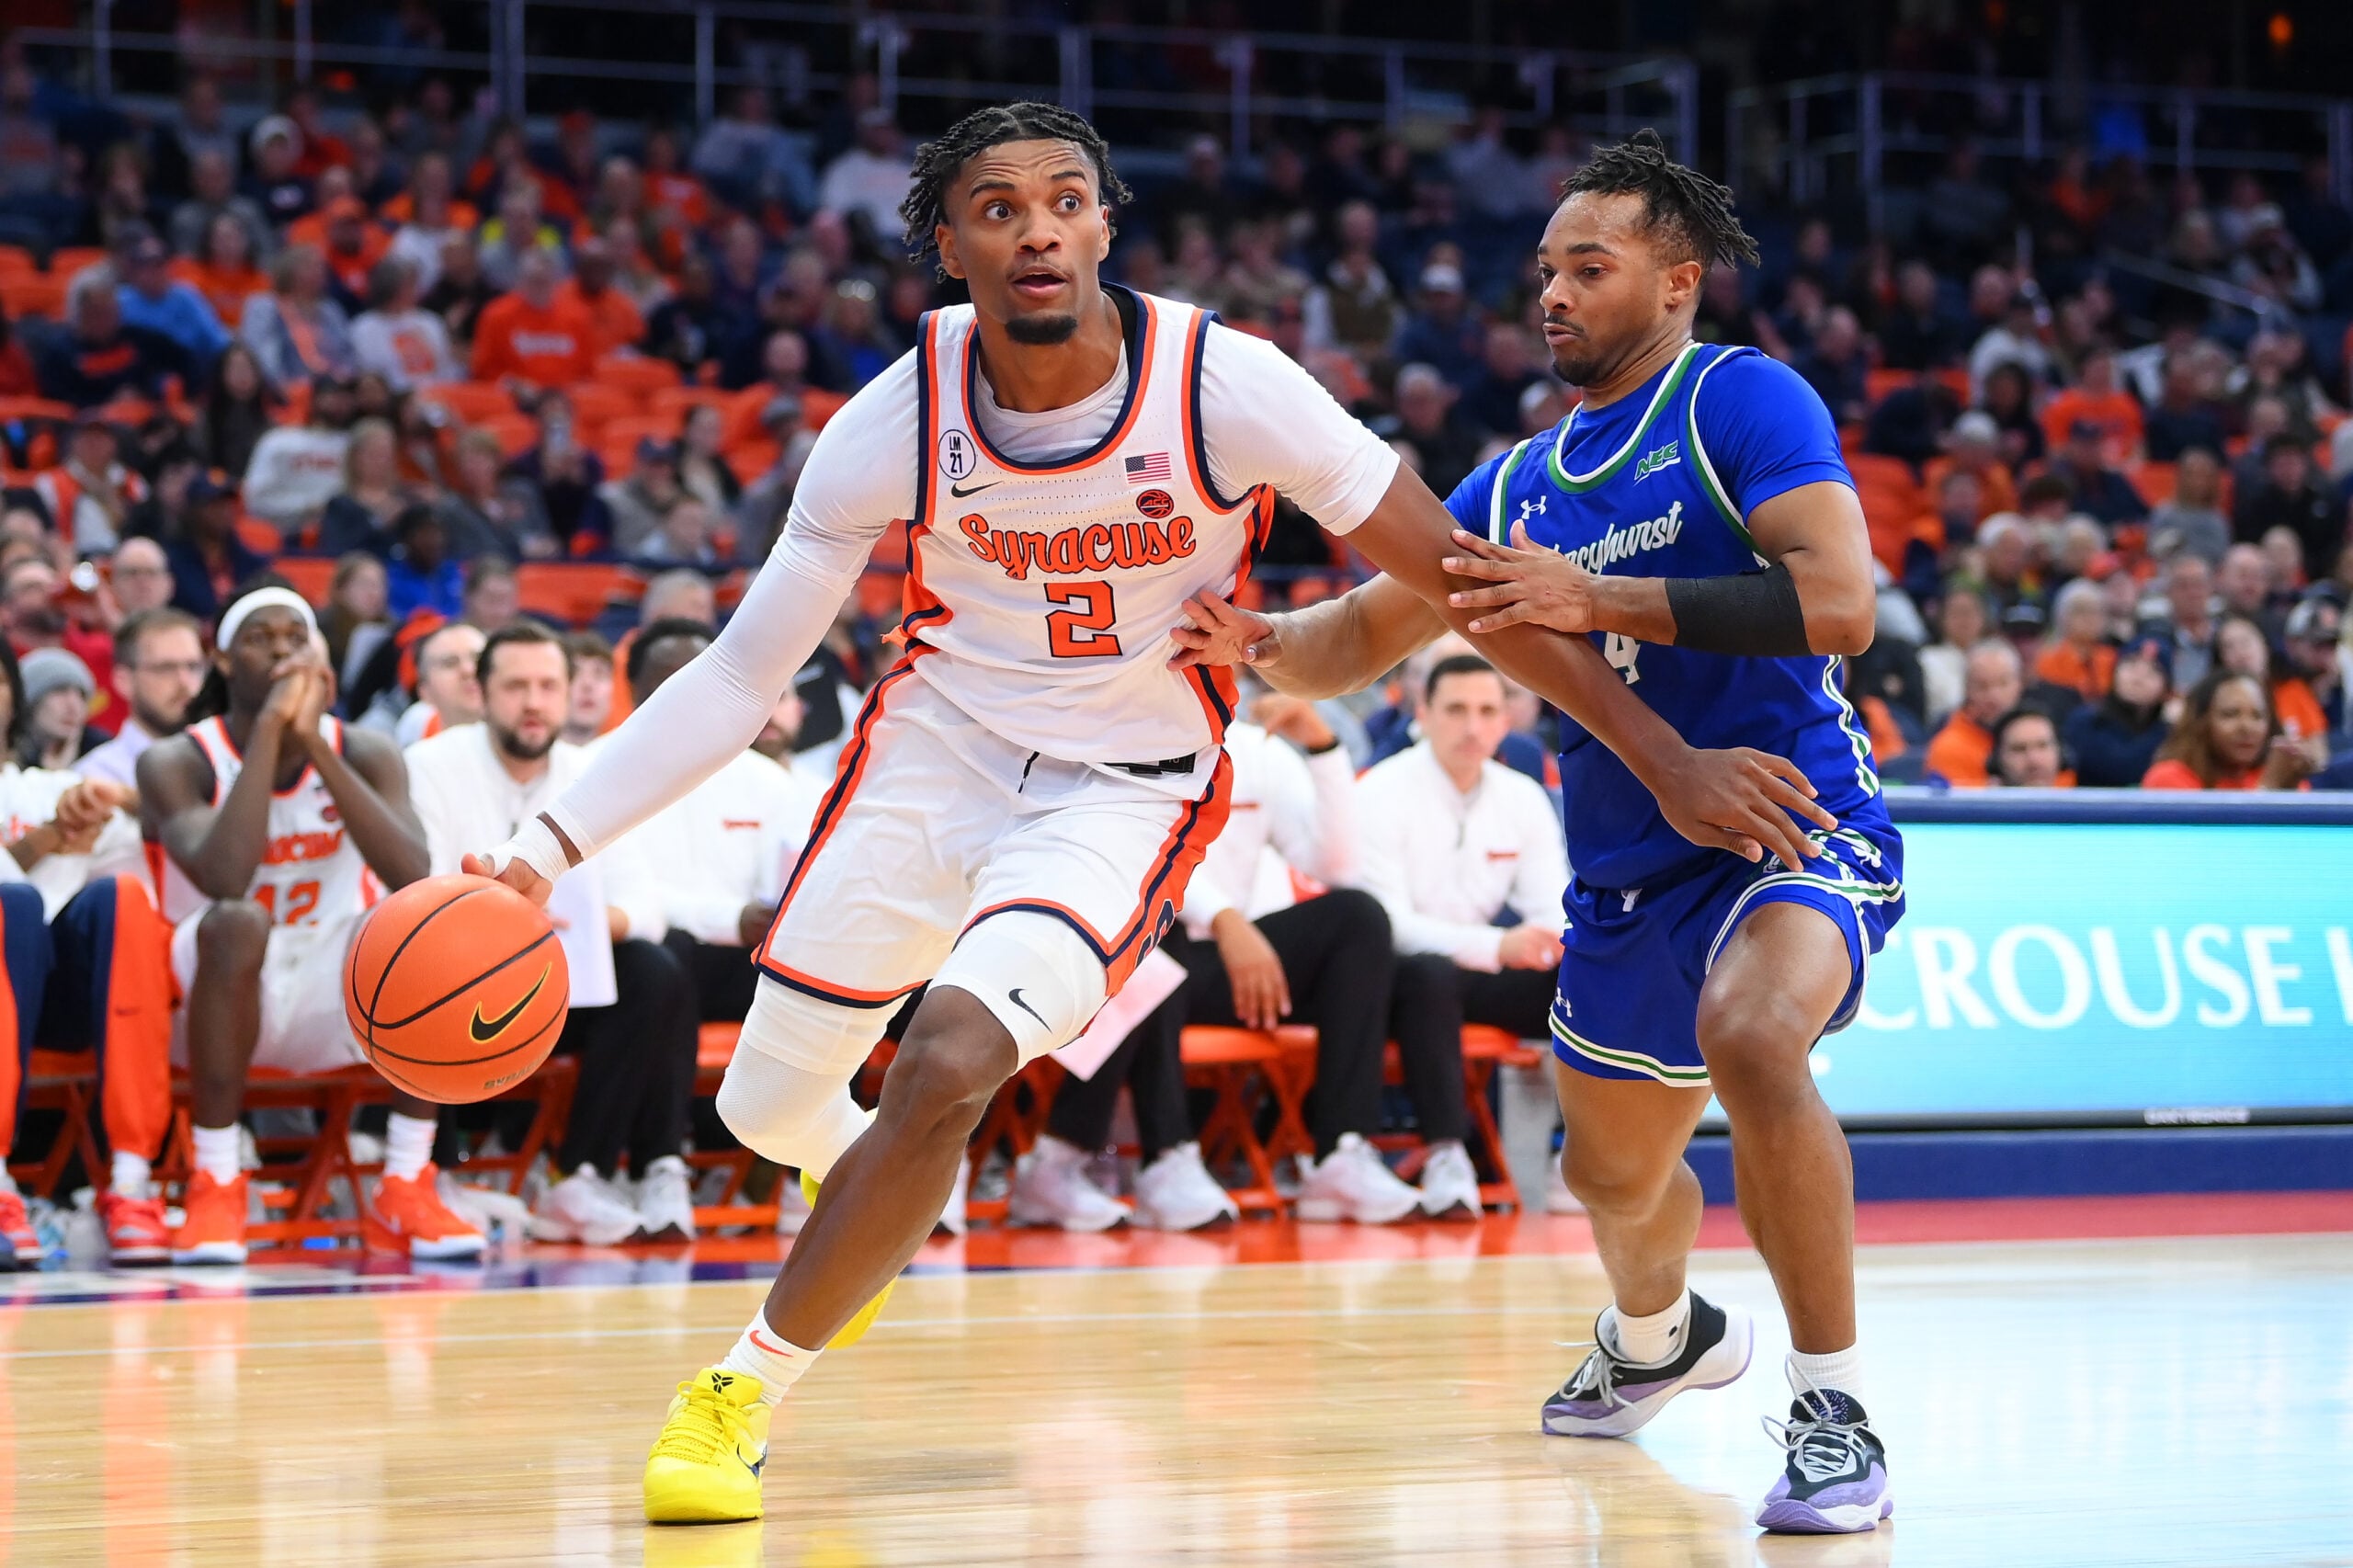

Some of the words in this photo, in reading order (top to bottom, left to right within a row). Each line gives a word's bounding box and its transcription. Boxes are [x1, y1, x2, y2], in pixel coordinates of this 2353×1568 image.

[949, 436, 961, 451] LM
[949, 451, 963, 474] 21
[1633, 438, 1678, 481] NEC
[959, 513, 1197, 581] Syracuse
[1043, 580, 1123, 658] 2
[1603, 631, 1642, 686] 4
